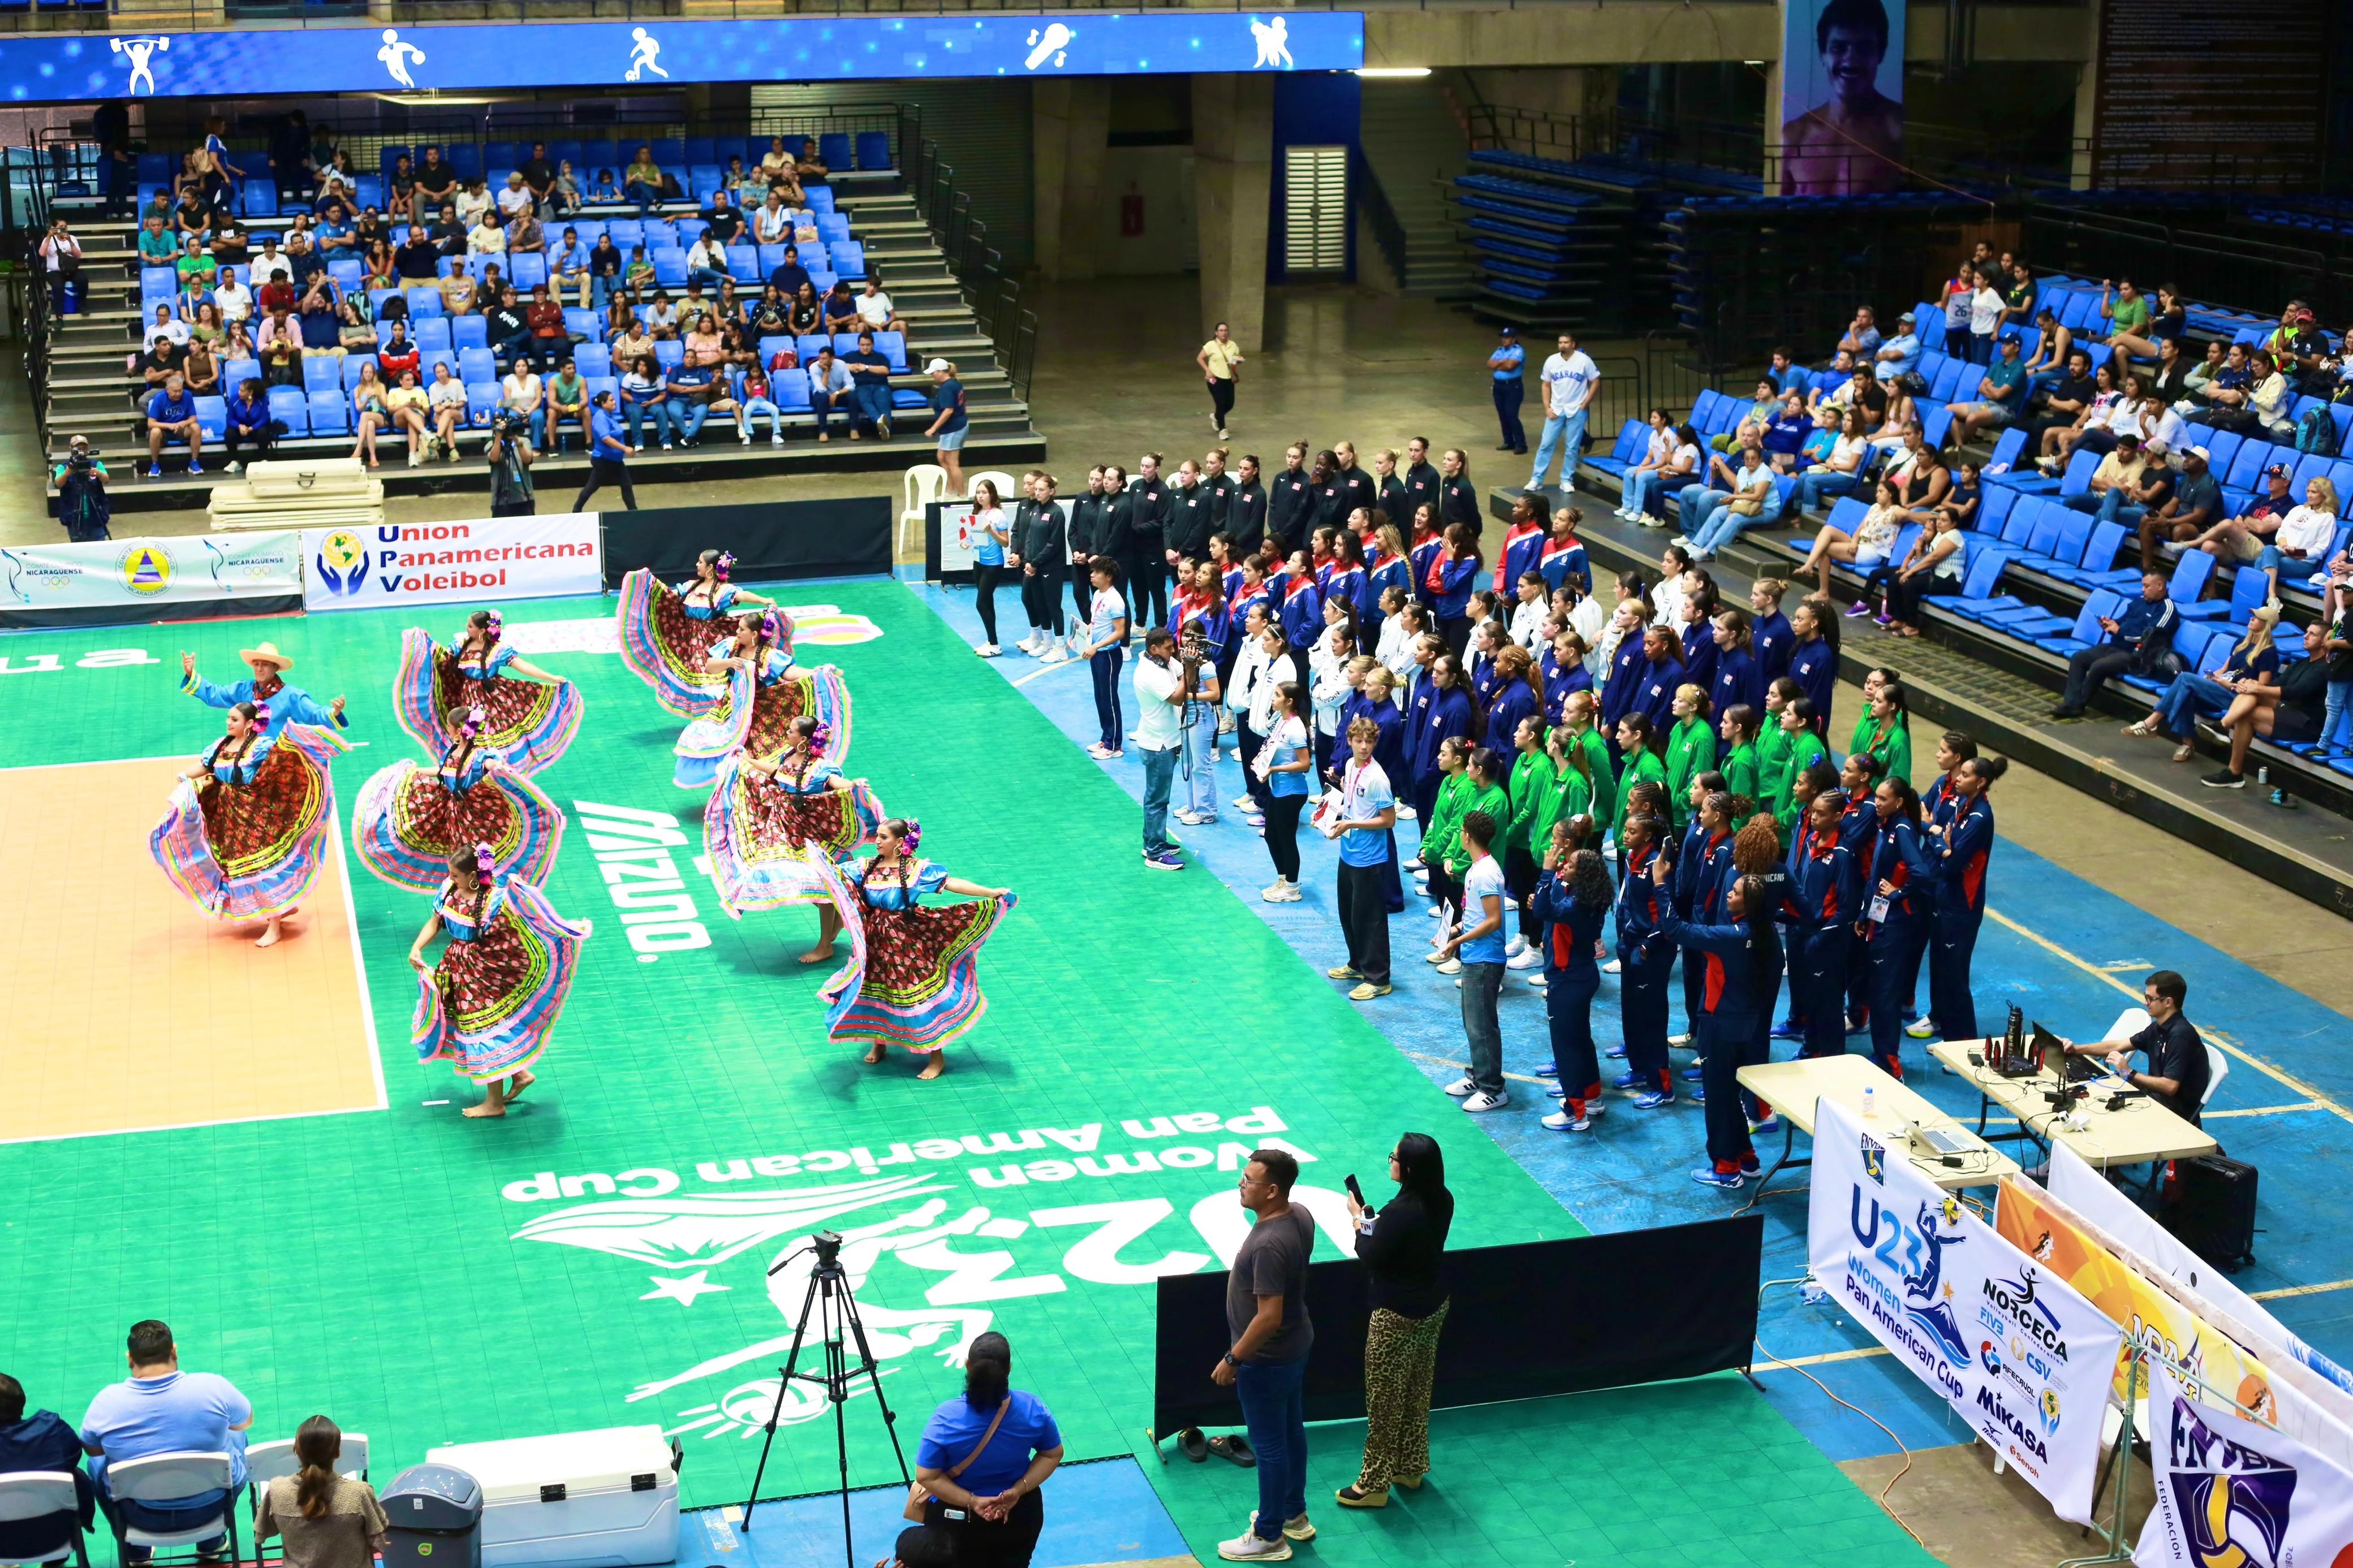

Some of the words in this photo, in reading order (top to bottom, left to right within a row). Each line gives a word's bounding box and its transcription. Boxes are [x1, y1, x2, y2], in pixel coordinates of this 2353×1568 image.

[801, 313, 809, 322] 5
[1955, 305, 1967, 317] 26
[378, 525, 469, 543] Union
[380, 542, 593, 568] Panamericana
[380, 568, 506, 592] Voleibol
[572, 800, 712, 953] MIZUNO
[1120, 1106, 1289, 1136] Pan
[696, 1122, 1102, 1182] American
[969, 1137, 1318, 1188] Women
[501, 1167, 680, 1202] Cup
[1360, 1223, 1371, 1232] TVN
[1852, 1182, 1921, 1276] U23
[1847, 1273, 1869, 1310] Pan
[1872, 1301, 1935, 1371] American
[1937, 1360, 1963, 1399] Cup
[1981, 1306, 2003, 1336] FIVB
[1983, 1278, 2068, 1362] NORCECA
[1986, 1300, 2016, 1328] Volleyball
[2020, 1328, 2063, 1367] Confederation
[2003, 1363, 2035, 1398] AFECAVOL
[2027, 1352, 2051, 1380] CSV
[2016, 1452, 2040, 1479] Senoh
[2158, 1480, 2182, 1561] FEDERACIÓN
